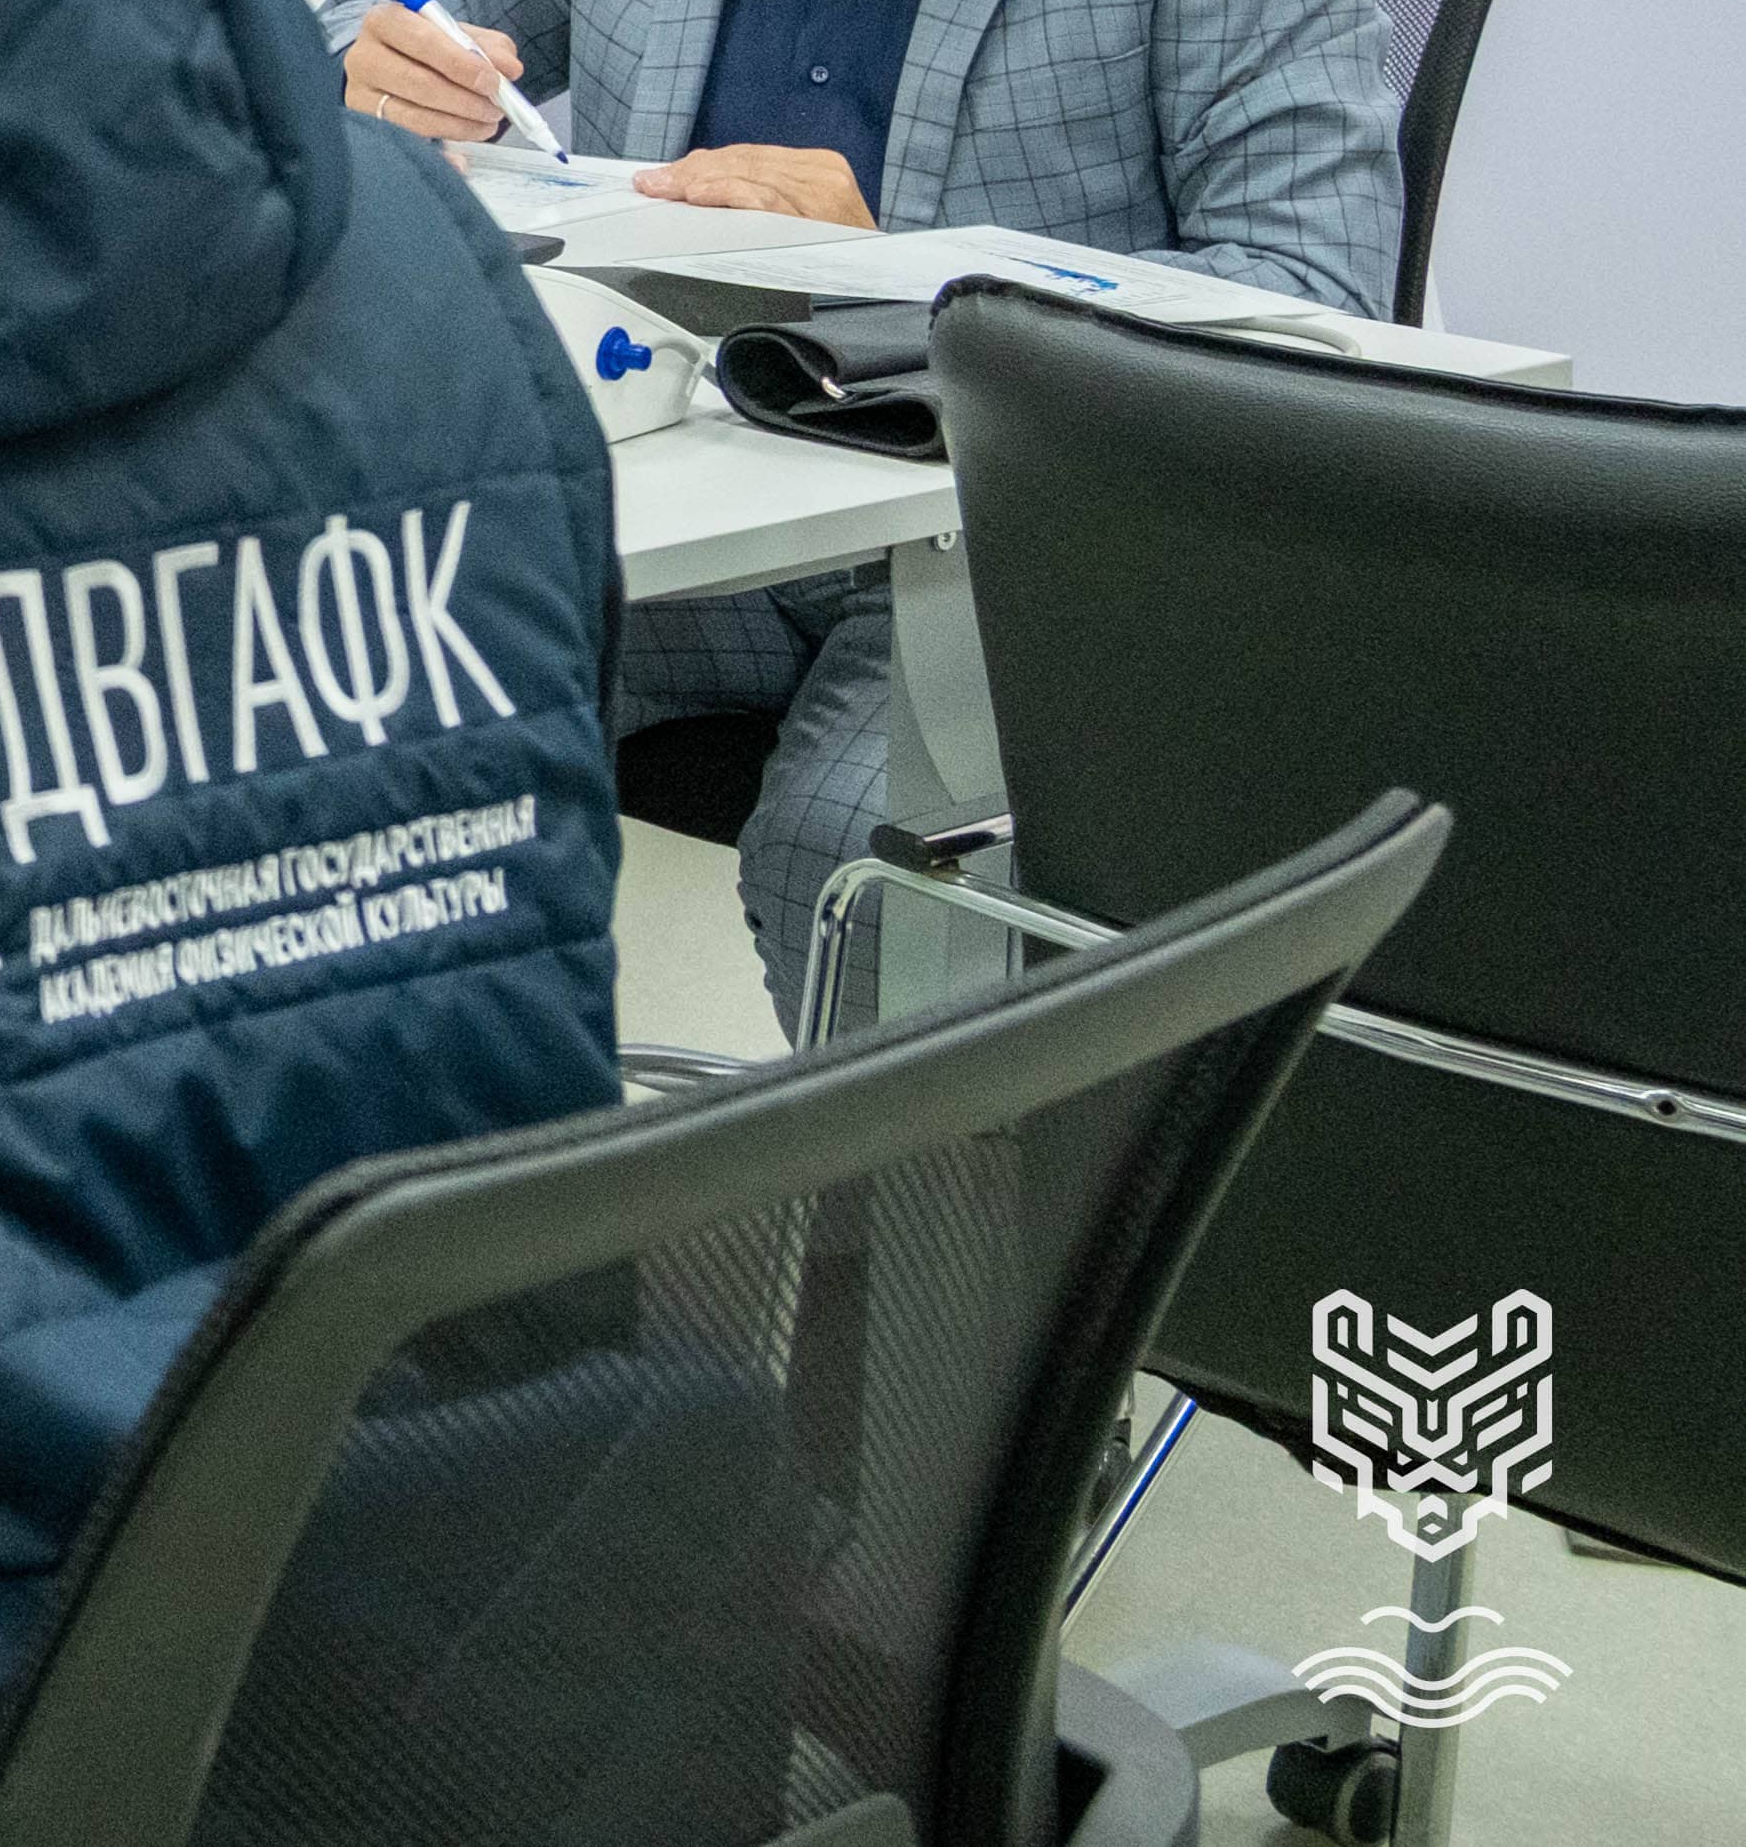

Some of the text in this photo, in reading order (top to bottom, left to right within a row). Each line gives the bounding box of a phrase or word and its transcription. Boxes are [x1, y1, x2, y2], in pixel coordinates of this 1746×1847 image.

[27, 792, 536, 968] ДАЛЬНЕВОСТОЧНАЯ ГОСУДАРСТВЕННАЯ
[37, 866, 509, 1026] АКАДЕМИЯ ФИЗИЧЕСКОЙ КУЛЬТУРЫ
